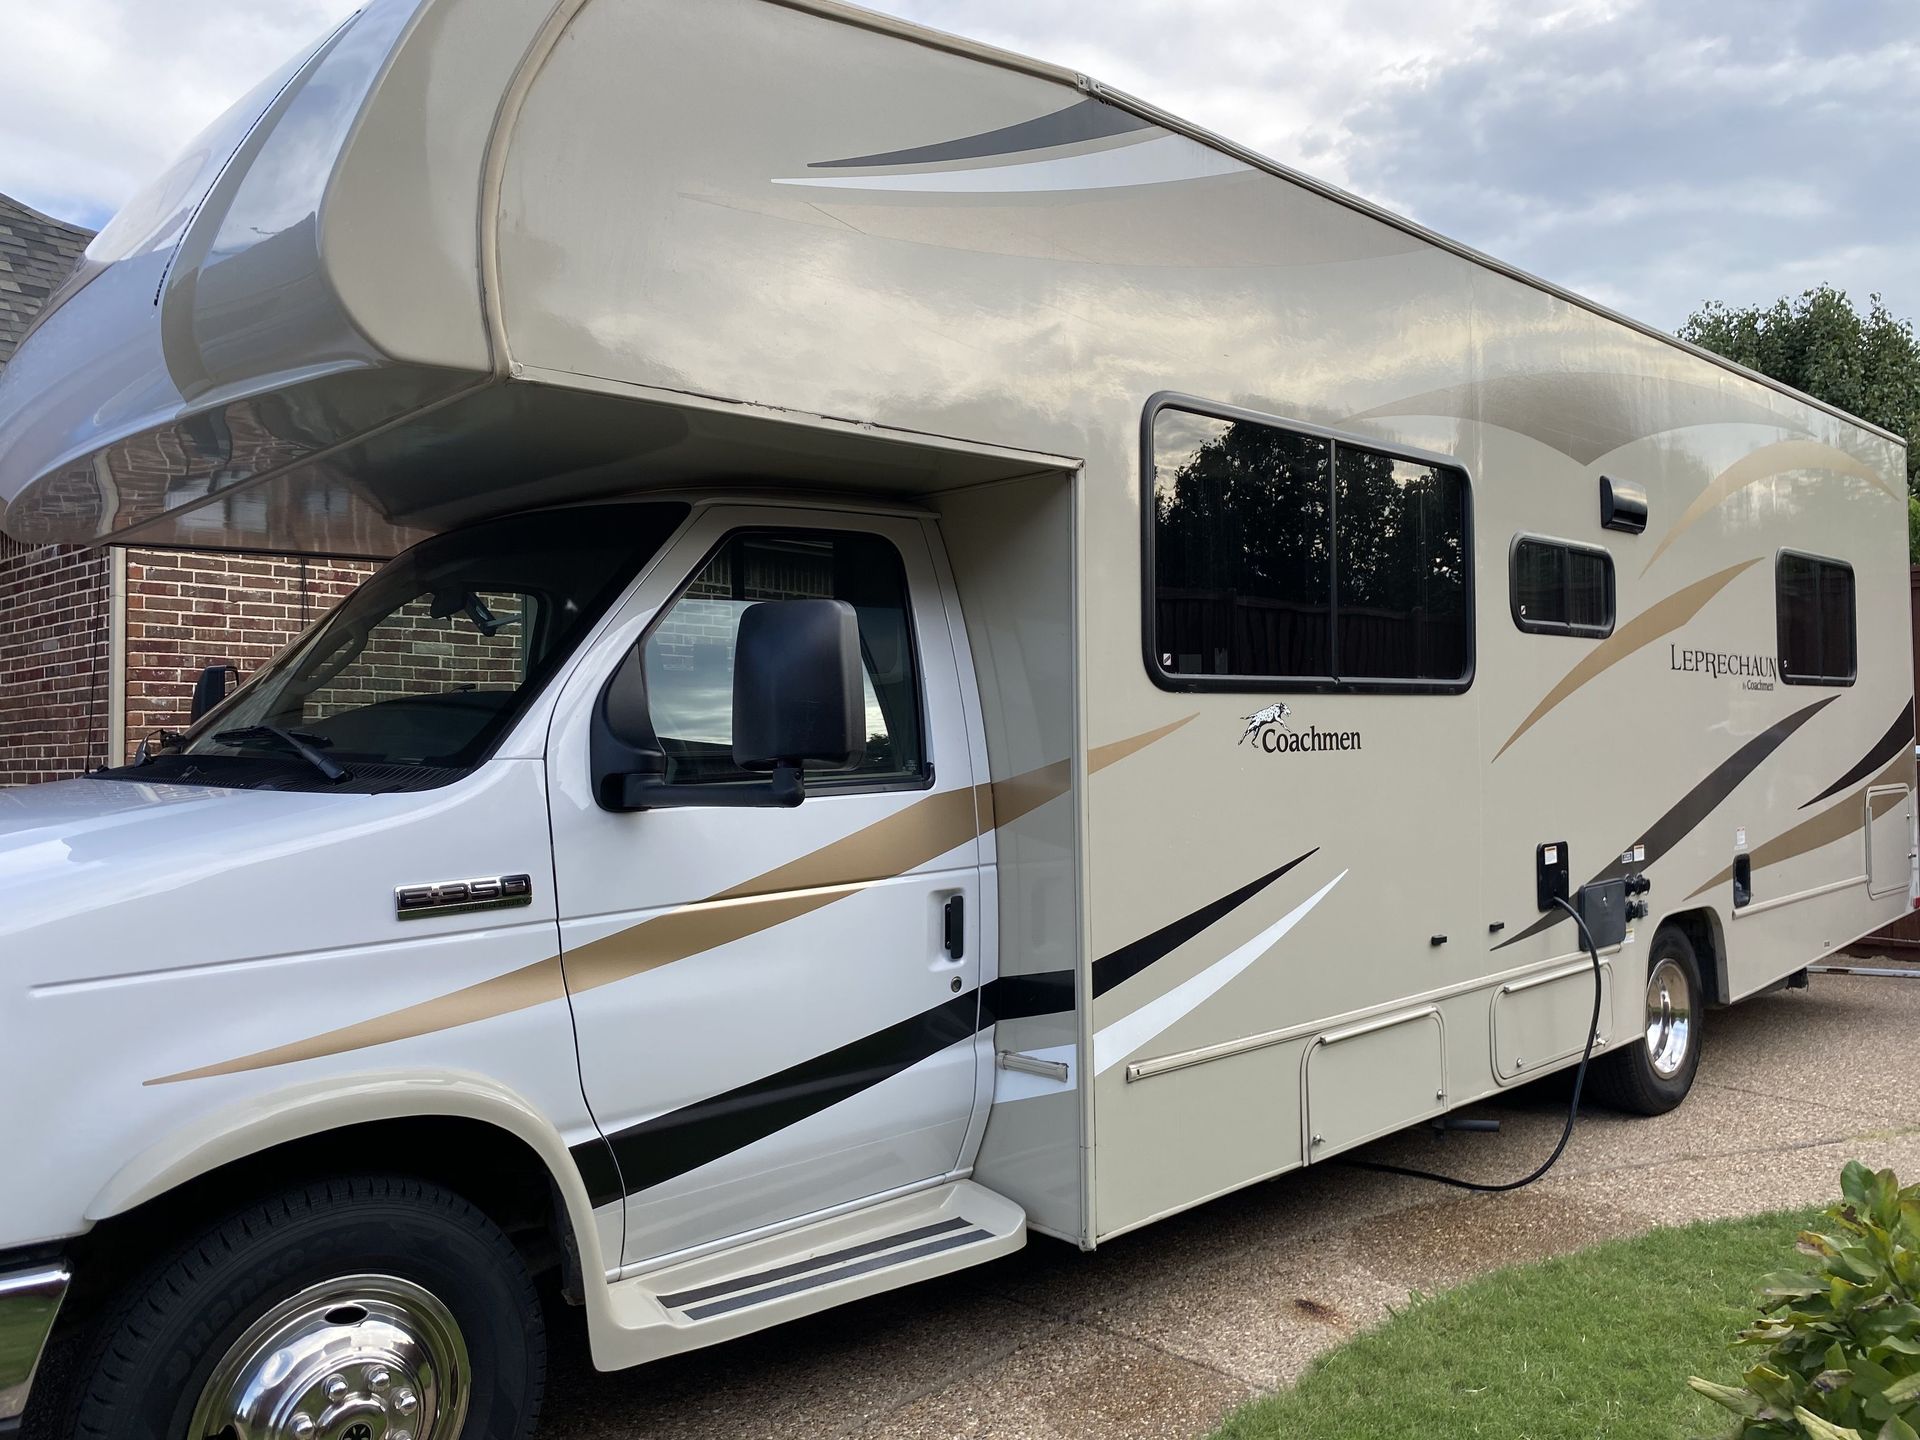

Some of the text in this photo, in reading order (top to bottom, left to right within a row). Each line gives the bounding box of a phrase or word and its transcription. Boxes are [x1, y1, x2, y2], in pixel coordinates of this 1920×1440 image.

[1671, 643, 1776, 682] LEPRECHAUN
[1747, 680, 1774, 691] Coachmen
[1263, 726, 1361, 753] Coachmen
[399, 873, 532, 908] E-350
